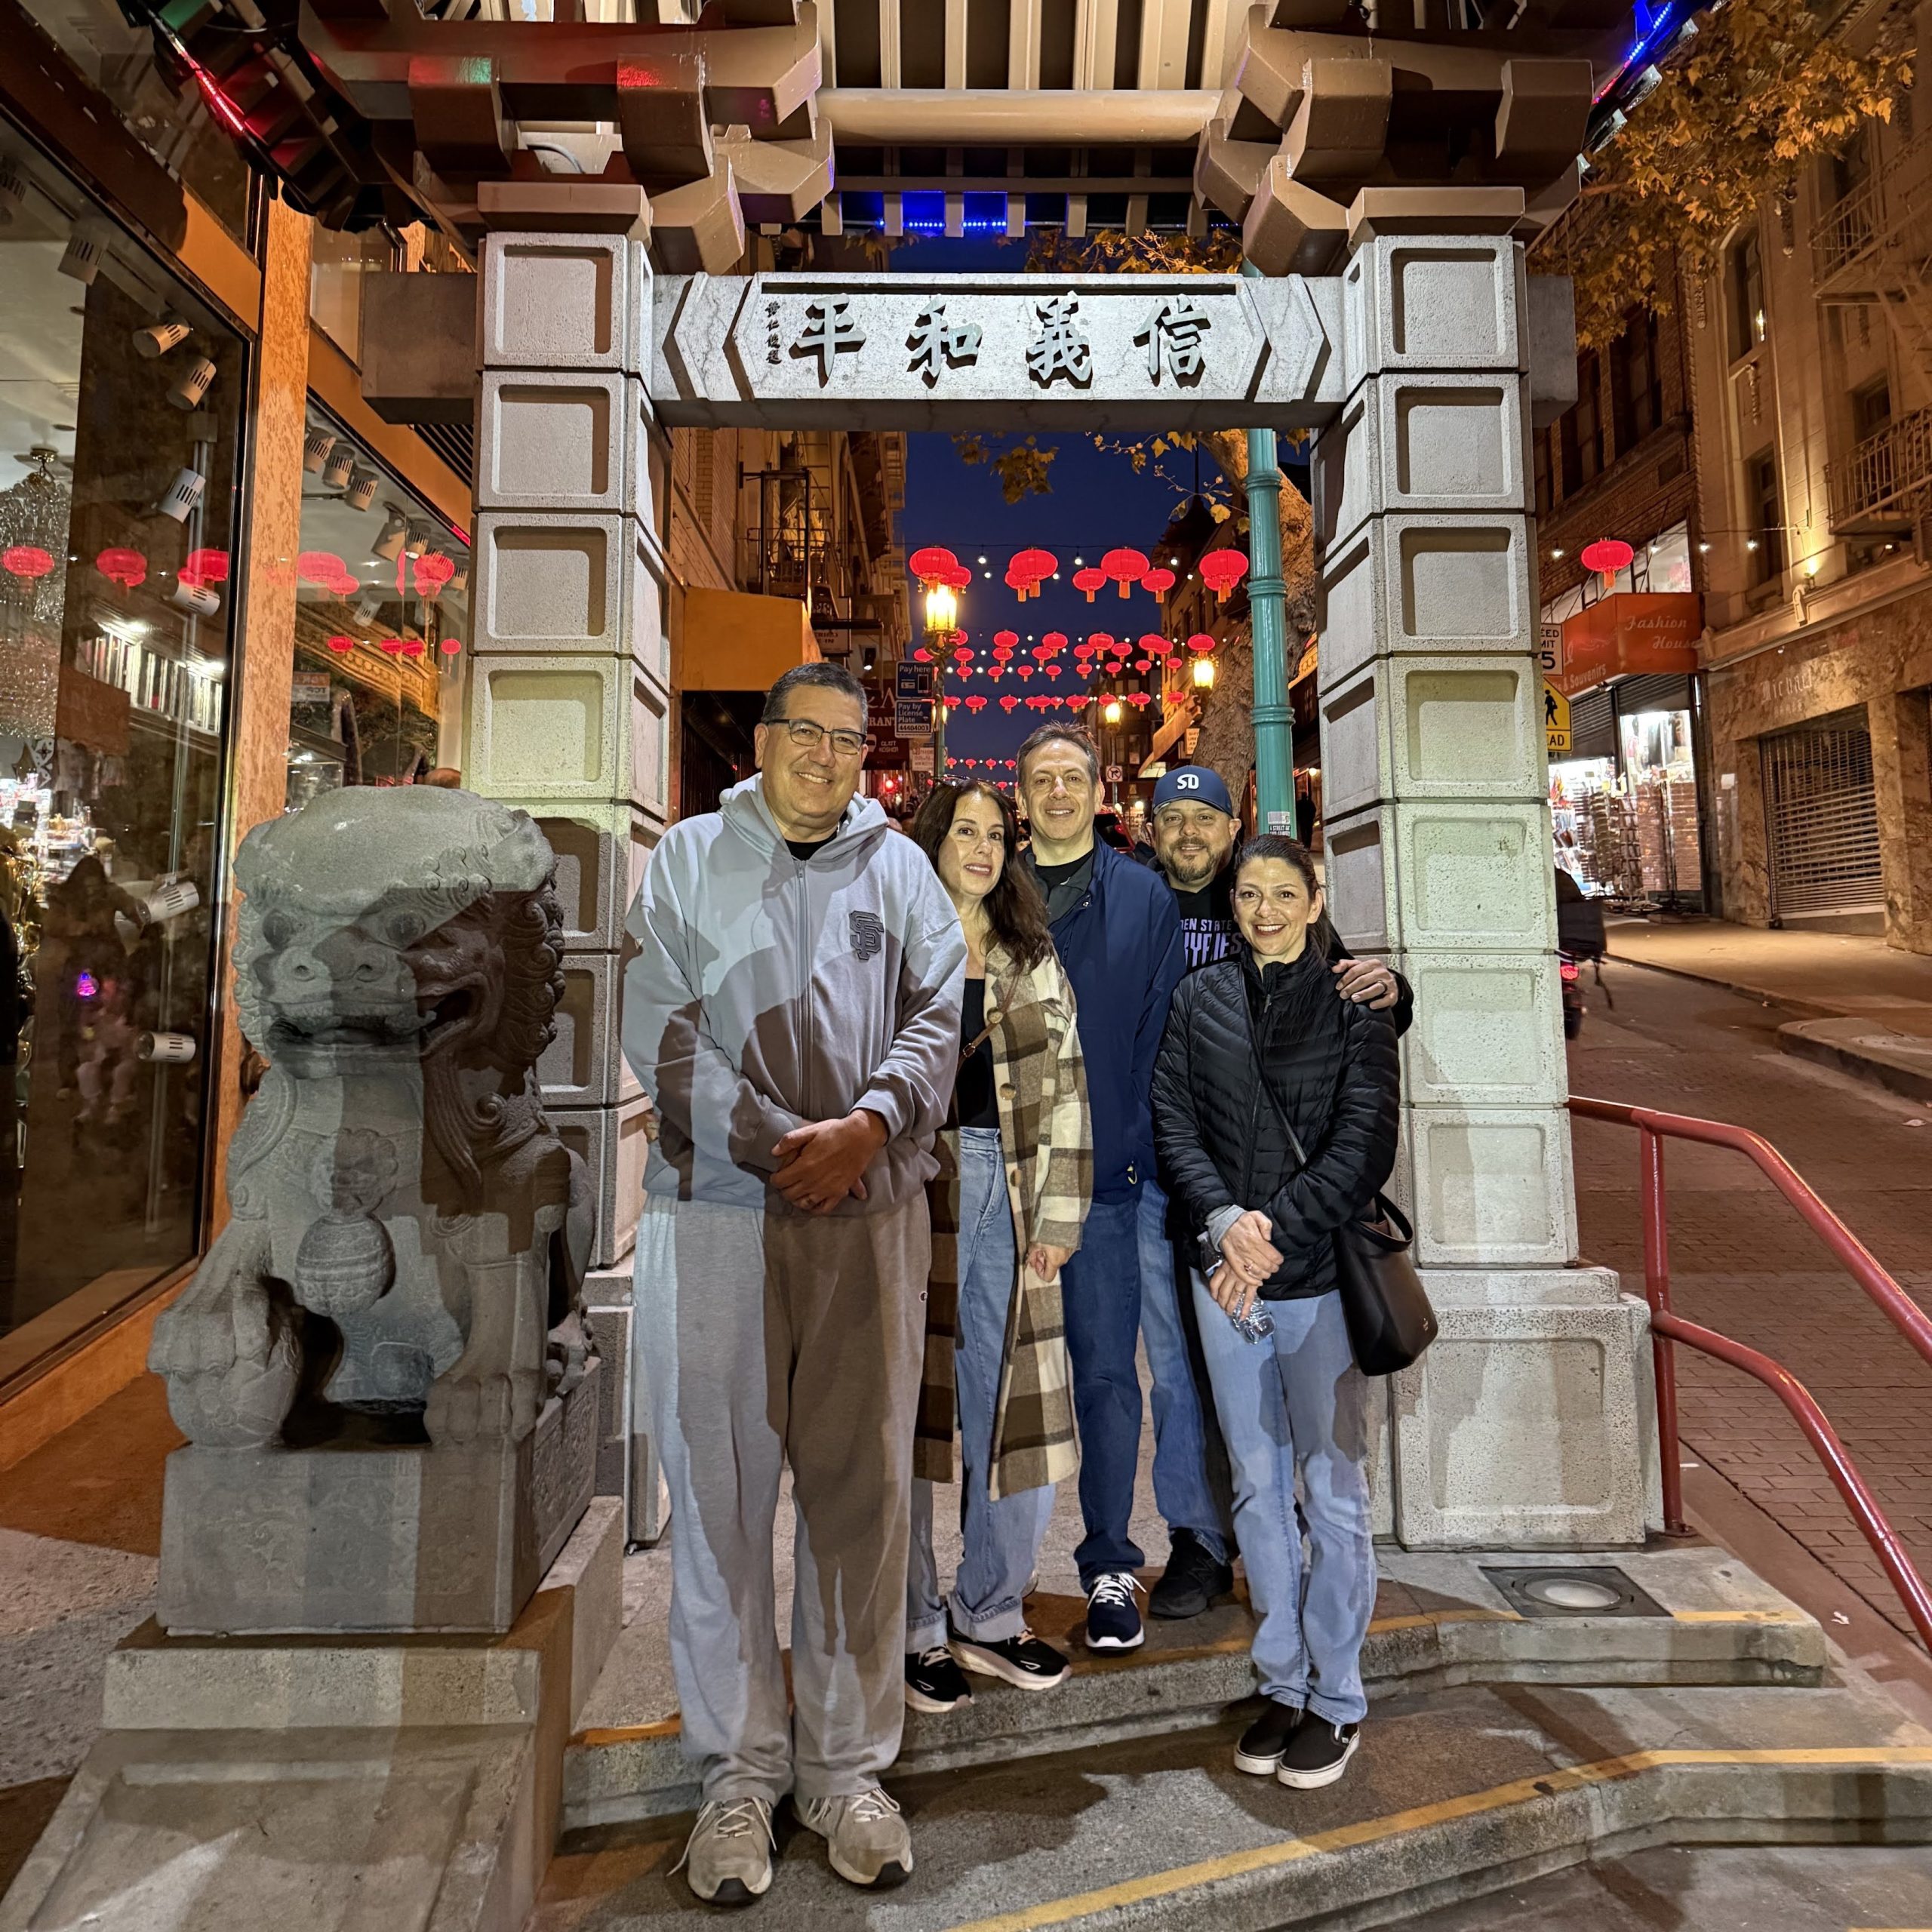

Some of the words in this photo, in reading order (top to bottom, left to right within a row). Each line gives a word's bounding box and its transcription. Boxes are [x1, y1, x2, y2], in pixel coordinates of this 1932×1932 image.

[1624, 615, 1687, 631] Fashion
[1540, 629, 1559, 638] EED
[899, 665, 912, 674] Pay
[1570, 663, 1607, 689] Souvenirs
[898, 703, 910, 711] Pay
[1177, 774, 1199, 790] SD
[1200, 918, 1232, 932] STATE
